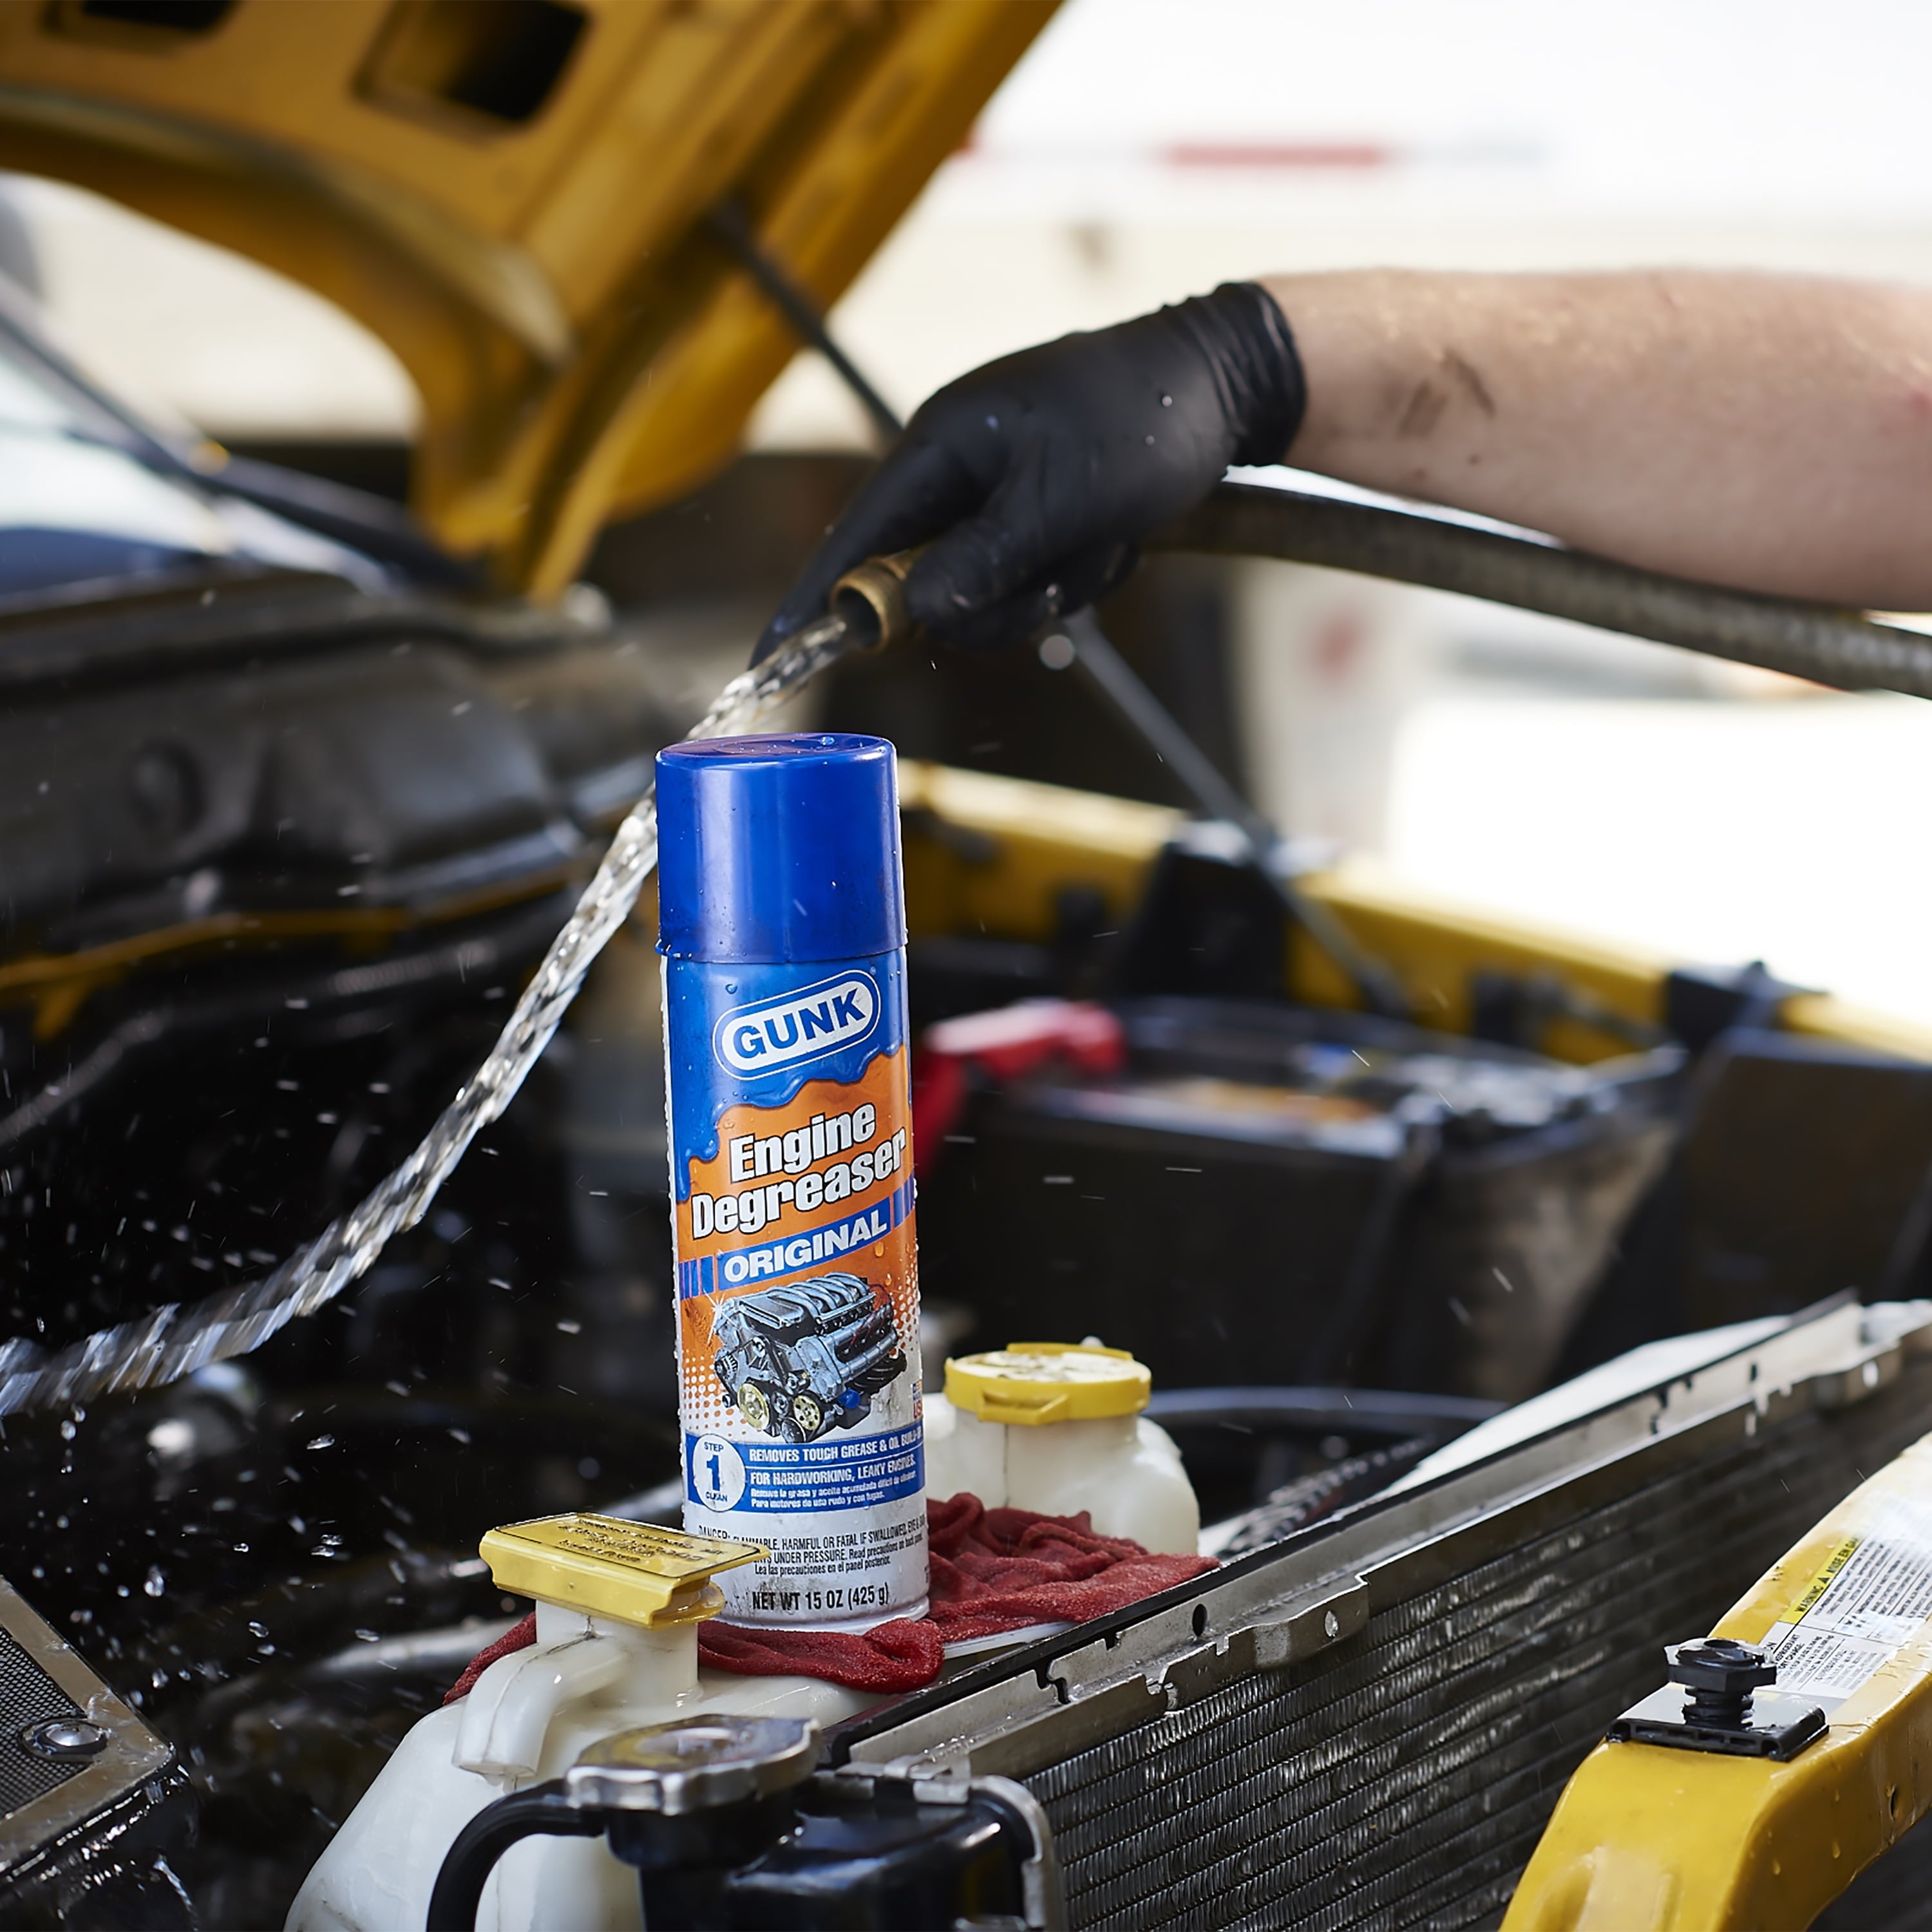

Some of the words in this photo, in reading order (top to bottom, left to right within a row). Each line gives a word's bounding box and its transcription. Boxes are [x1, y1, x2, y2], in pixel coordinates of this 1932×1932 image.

[732, 988, 866, 1058] GUNK
[730, 1103, 876, 1183] Engine
[692, 1127, 906, 1240] Degreaser
[724, 1218, 887, 1282] ORIGINAL
[704, 1441, 724, 1452] STEP
[750, 1449, 800, 1462] REMOVES
[803, 1447, 837, 1461] TOUGH
[841, 1441, 877, 1458] GREASE
[880, 1439, 887, 1452] &
[889, 1436, 900, 1449] OIL
[706, 1455, 720, 1491] 1
[750, 1472, 770, 1485] FOR
[773, 1468, 855, 1485] HARDWORKING,
[858, 1463, 886, 1479] LEAKY
[705, 1492, 728, 1502] CLEAN
[752, 1499, 769, 1508] Para
[802, 1499, 811, 1507] de
[829, 1496, 846, 1505] rudo
[847, 1496, 851, 1504] y
[853, 1494, 866, 1503] con
[780, 1489, 786, 1497] la
[788, 1489, 810, 1499] grasa
[812, 1489, 817, 1497] y
[819, 1487, 840, 1495] aceite
[782, 1537, 821, 1550] HARMFUL
[824, 1536, 835, 1549] OR
[837, 1533, 858, 1547] FATAL
[860, 1531, 867, 1544] IF
[774, 1551, 800, 1564] UNDER
[804, 1549, 848, 1563] PRESSURE.
[849, 1548, 866, 1558] Read
[867, 1542, 898, 1558] precautions
[755, 1564, 767, 1575] Lea
[768, 1565, 779, 1575] las
[780, 1564, 826, 1577] precauciones
[828, 1564, 836, 1573] en
[838, 1562, 844, 1572] el
[846, 1559, 863, 1573] panel
[1794, 1586, 1824, 1612] WARNING
[1838, 1549, 1851, 1558] EN
[752, 1591, 775, 1610] NET
[780, 1591, 800, 1610] WT
[805, 1591, 821, 1609] 15
[826, 1589, 843, 1609] OZ
[848, 1585, 875, 1610] (425
[878, 1582, 888, 1605] g)
